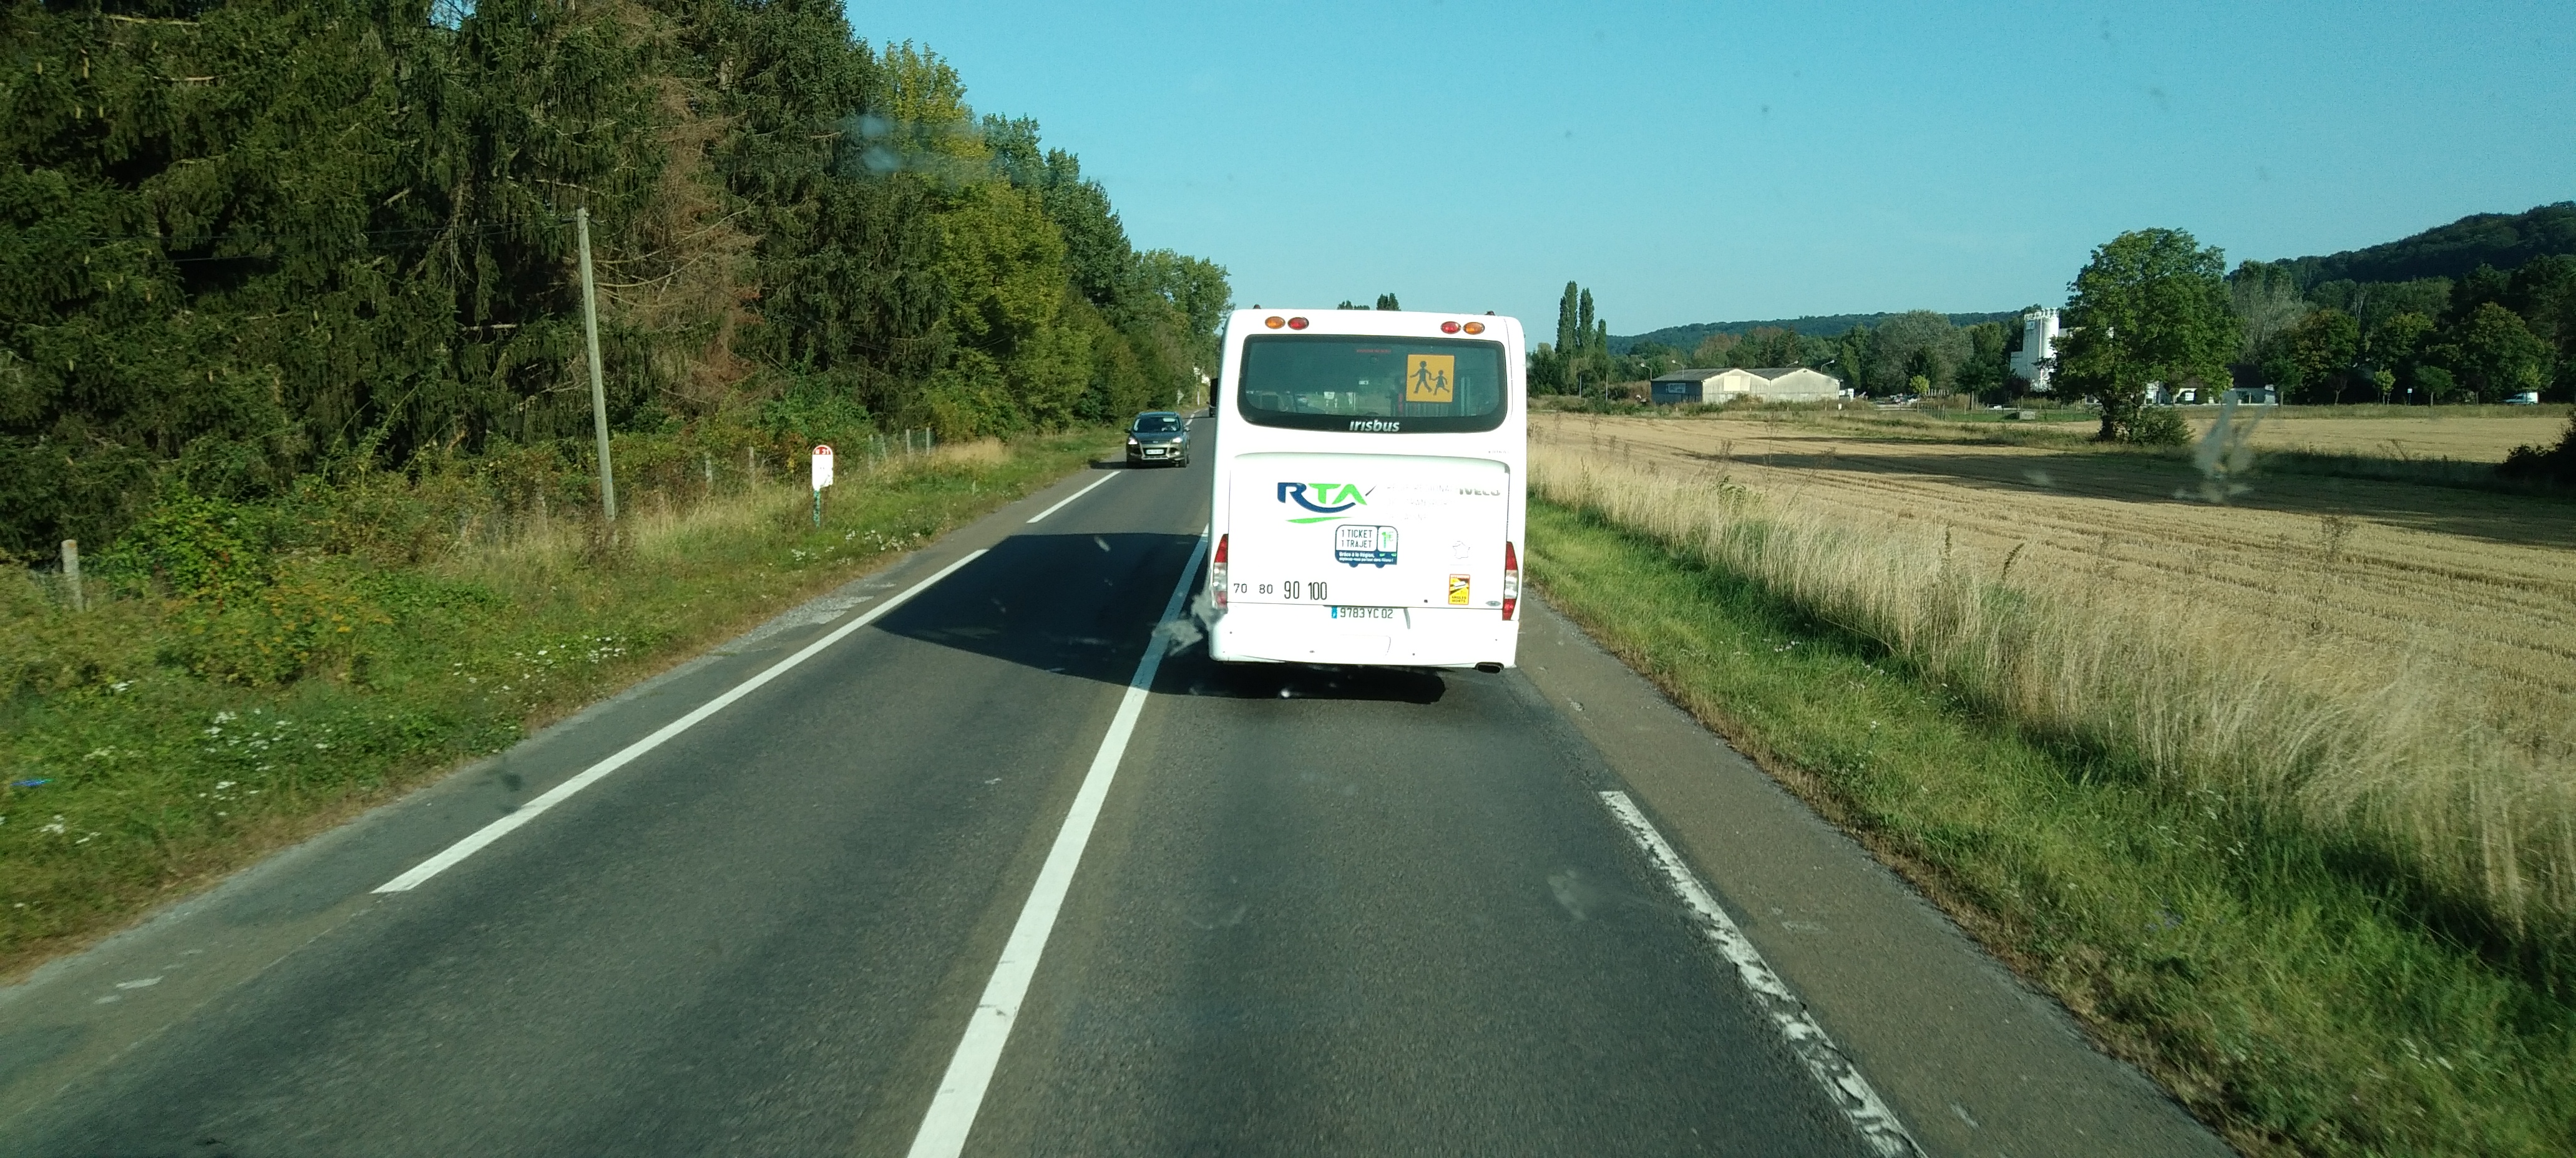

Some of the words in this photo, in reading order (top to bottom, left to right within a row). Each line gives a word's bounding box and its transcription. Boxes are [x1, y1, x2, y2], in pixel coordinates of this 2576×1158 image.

[1349, 419, 1400, 432] irisbus
[1277, 482, 1367, 513] RTA
[1347, 529, 1372, 538] TICKET
[1347, 540, 1372, 548] TRAJET
[1233, 583, 1247, 593] 70
[1259, 584, 1273, 594] 80
[1284, 581, 1300, 599] 90
[1308, 581, 1327, 600] 100
[1340, 608, 1365, 618] 9783
[1367, 608, 1379, 618] YC
[1381, 608, 1393, 619] 02
